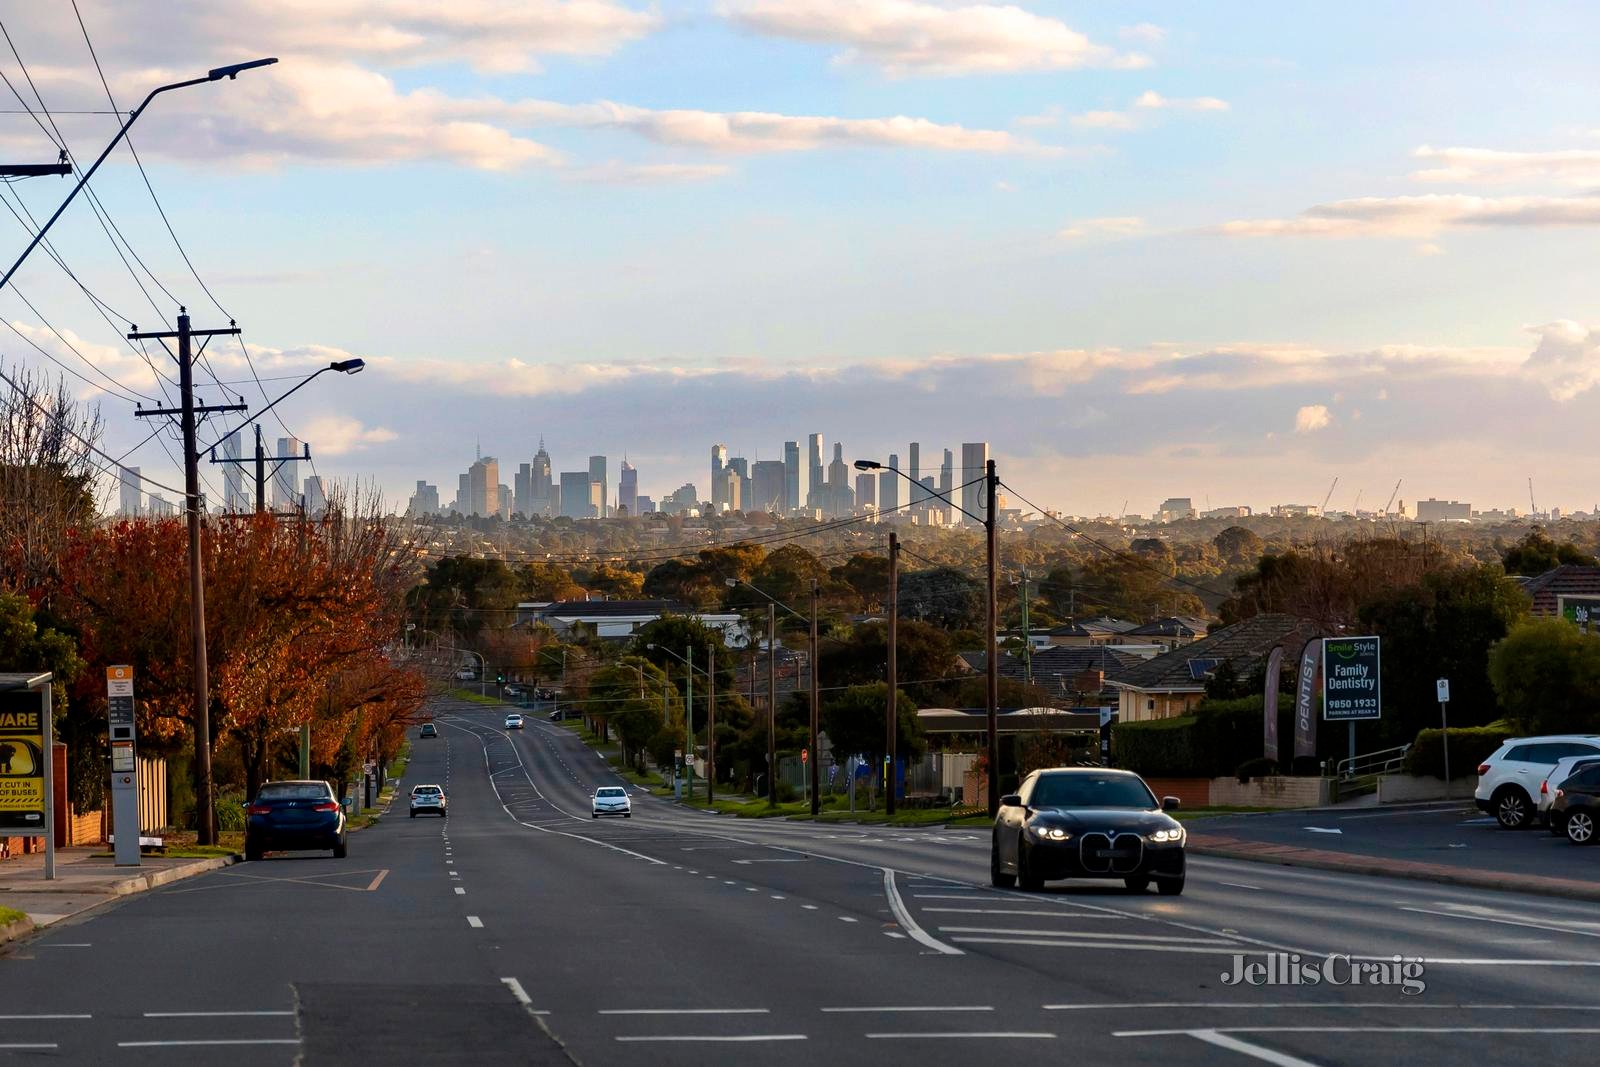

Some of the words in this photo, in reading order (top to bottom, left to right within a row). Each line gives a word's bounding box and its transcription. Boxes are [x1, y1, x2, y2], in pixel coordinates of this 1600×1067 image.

[1328, 643, 1352, 652] Smile
[1354, 642, 1376, 653] Style
[1335, 664, 1368, 678] Family
[1329, 677, 1375, 691] Dentistry
[1300, 654, 1314, 731] DENTIST
[1354, 699, 1376, 707] 1933
